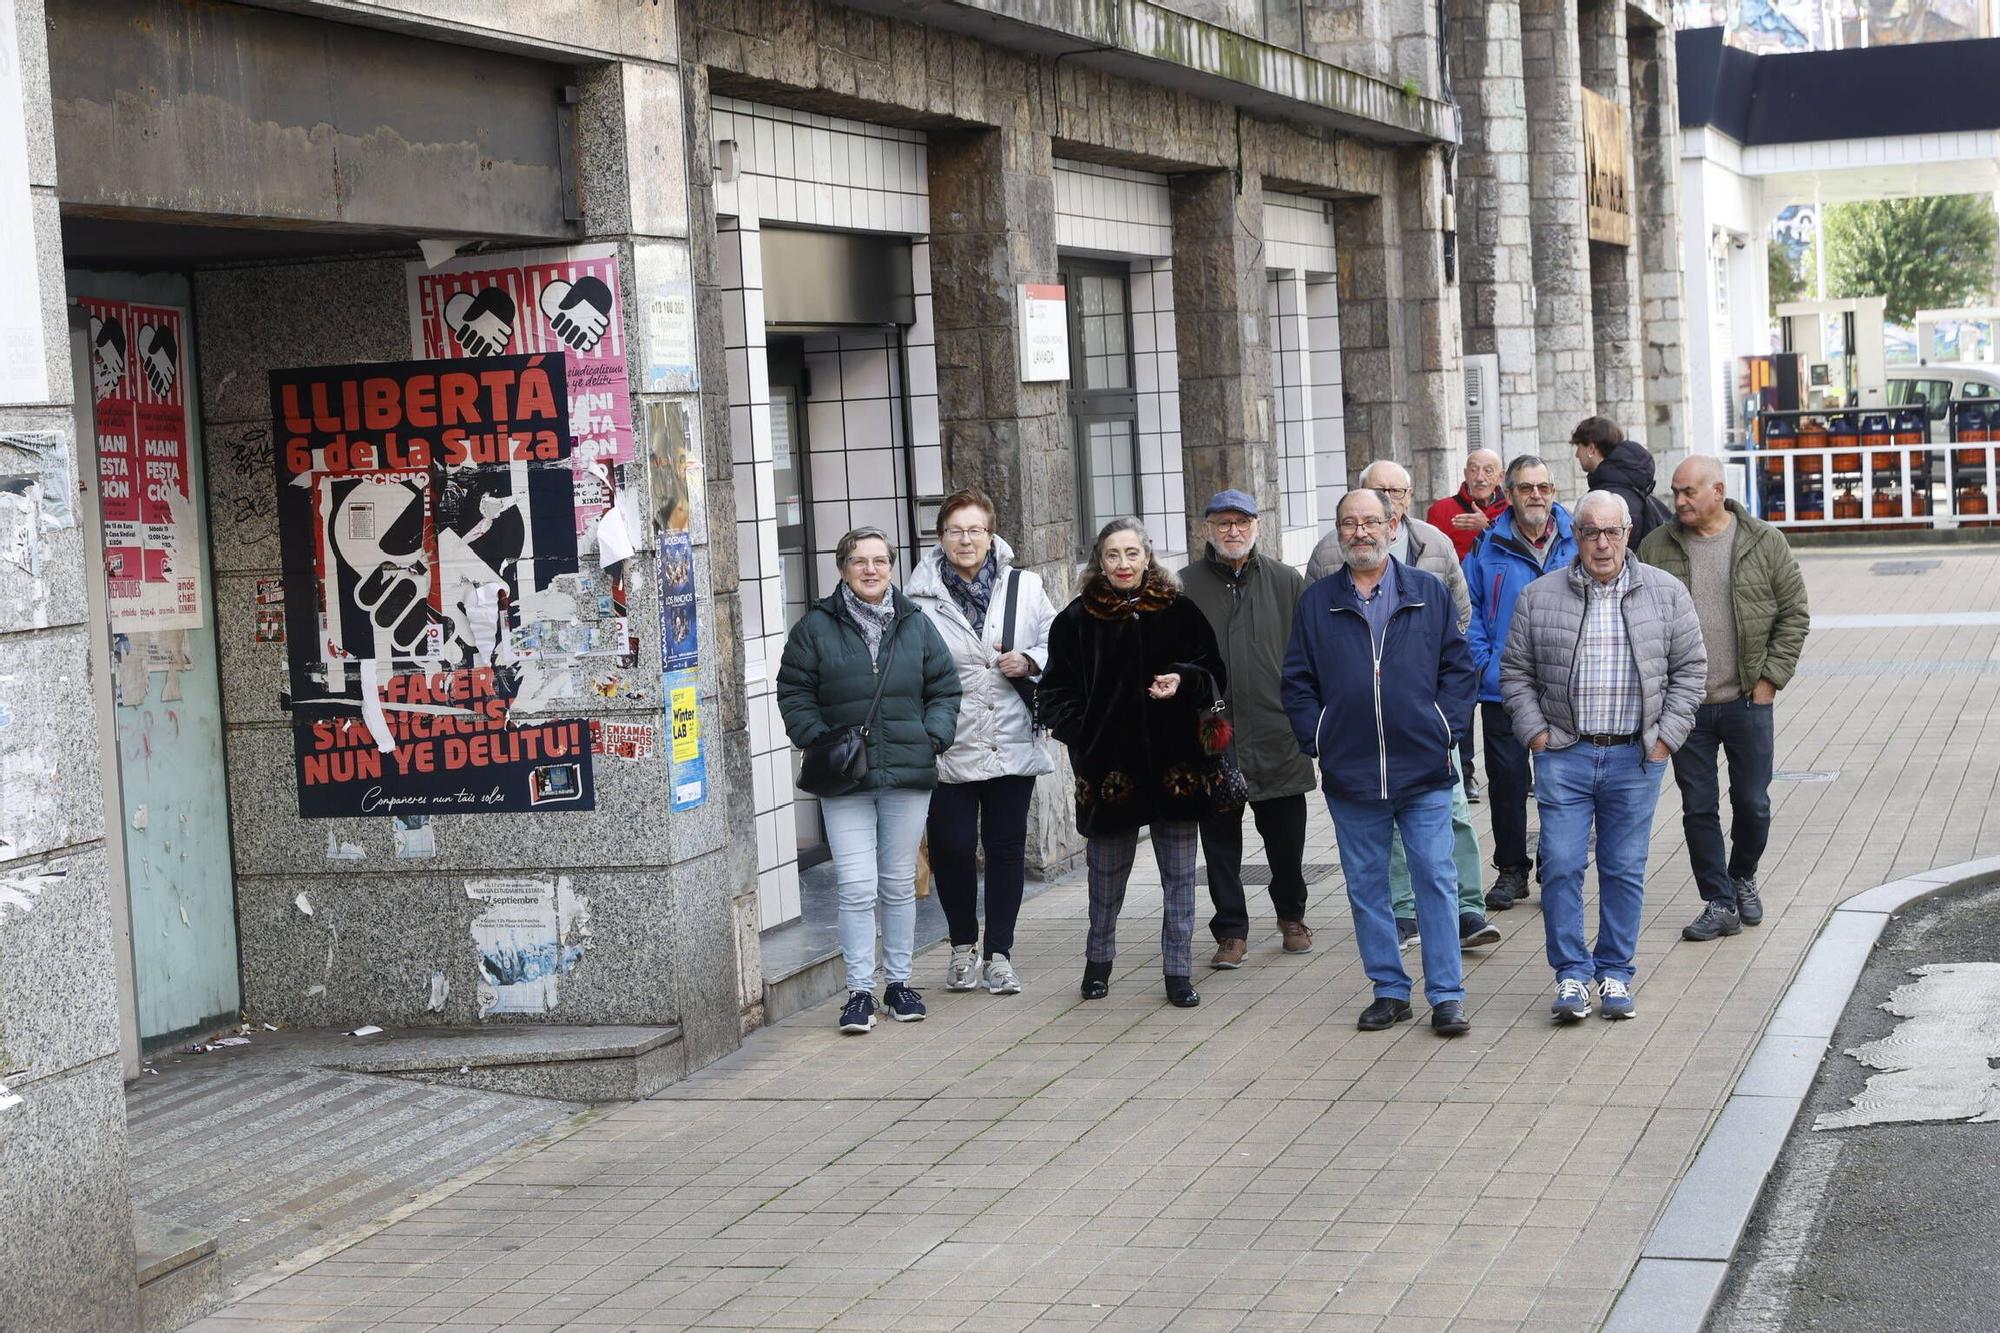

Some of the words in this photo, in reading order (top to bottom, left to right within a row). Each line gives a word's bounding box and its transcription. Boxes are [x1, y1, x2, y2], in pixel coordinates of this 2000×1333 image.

[281, 356, 558, 434] LLIBERTÁ
[145, 439, 178, 457] MANI
[286, 437, 312, 473] 6
[323, 433, 374, 473] de
[385, 433, 431, 468] La
[441, 425, 560, 467] Suiza
[146, 461, 180, 480] FESTA
[673, 707, 695, 722] Winter
[672, 723, 687, 740] LAB
[304, 750, 382, 785] NUN
[394, 742, 434, 775] YE
[444, 724, 580, 770] DELITU!
[492, 895, 539, 905] septiembre
